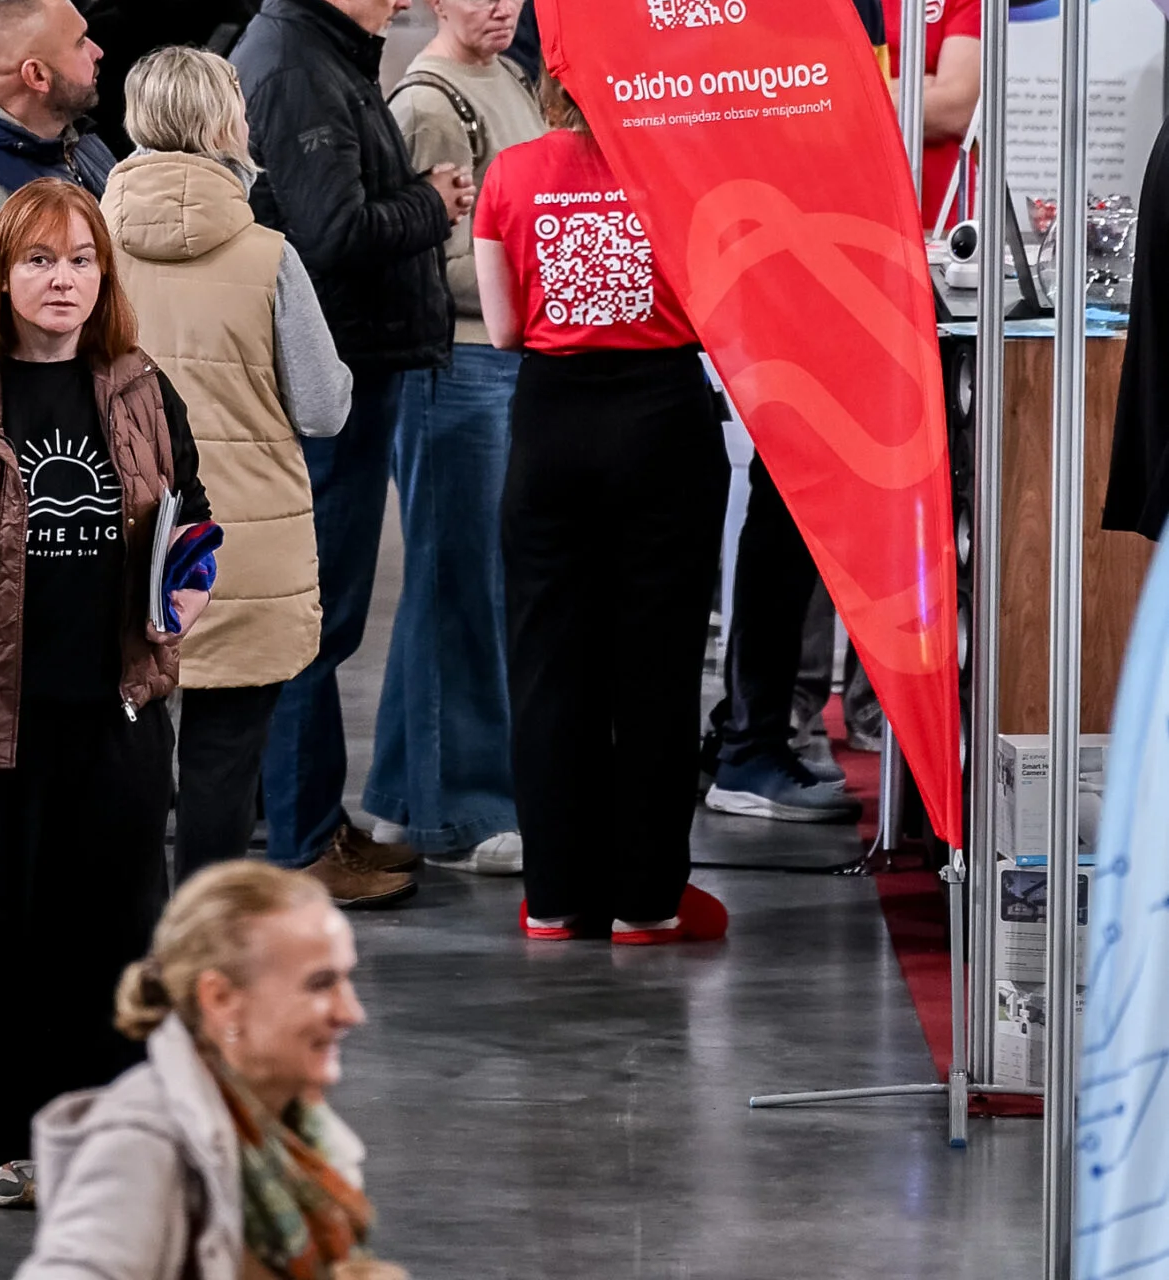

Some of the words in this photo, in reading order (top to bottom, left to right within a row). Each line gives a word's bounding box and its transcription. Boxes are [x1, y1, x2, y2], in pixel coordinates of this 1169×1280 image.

[533, 192, 603, 208] saugumo
[26, 528, 65, 542] THE
[80, 526, 117, 540] LIG
[27, 549, 73, 558] MATTHEW
